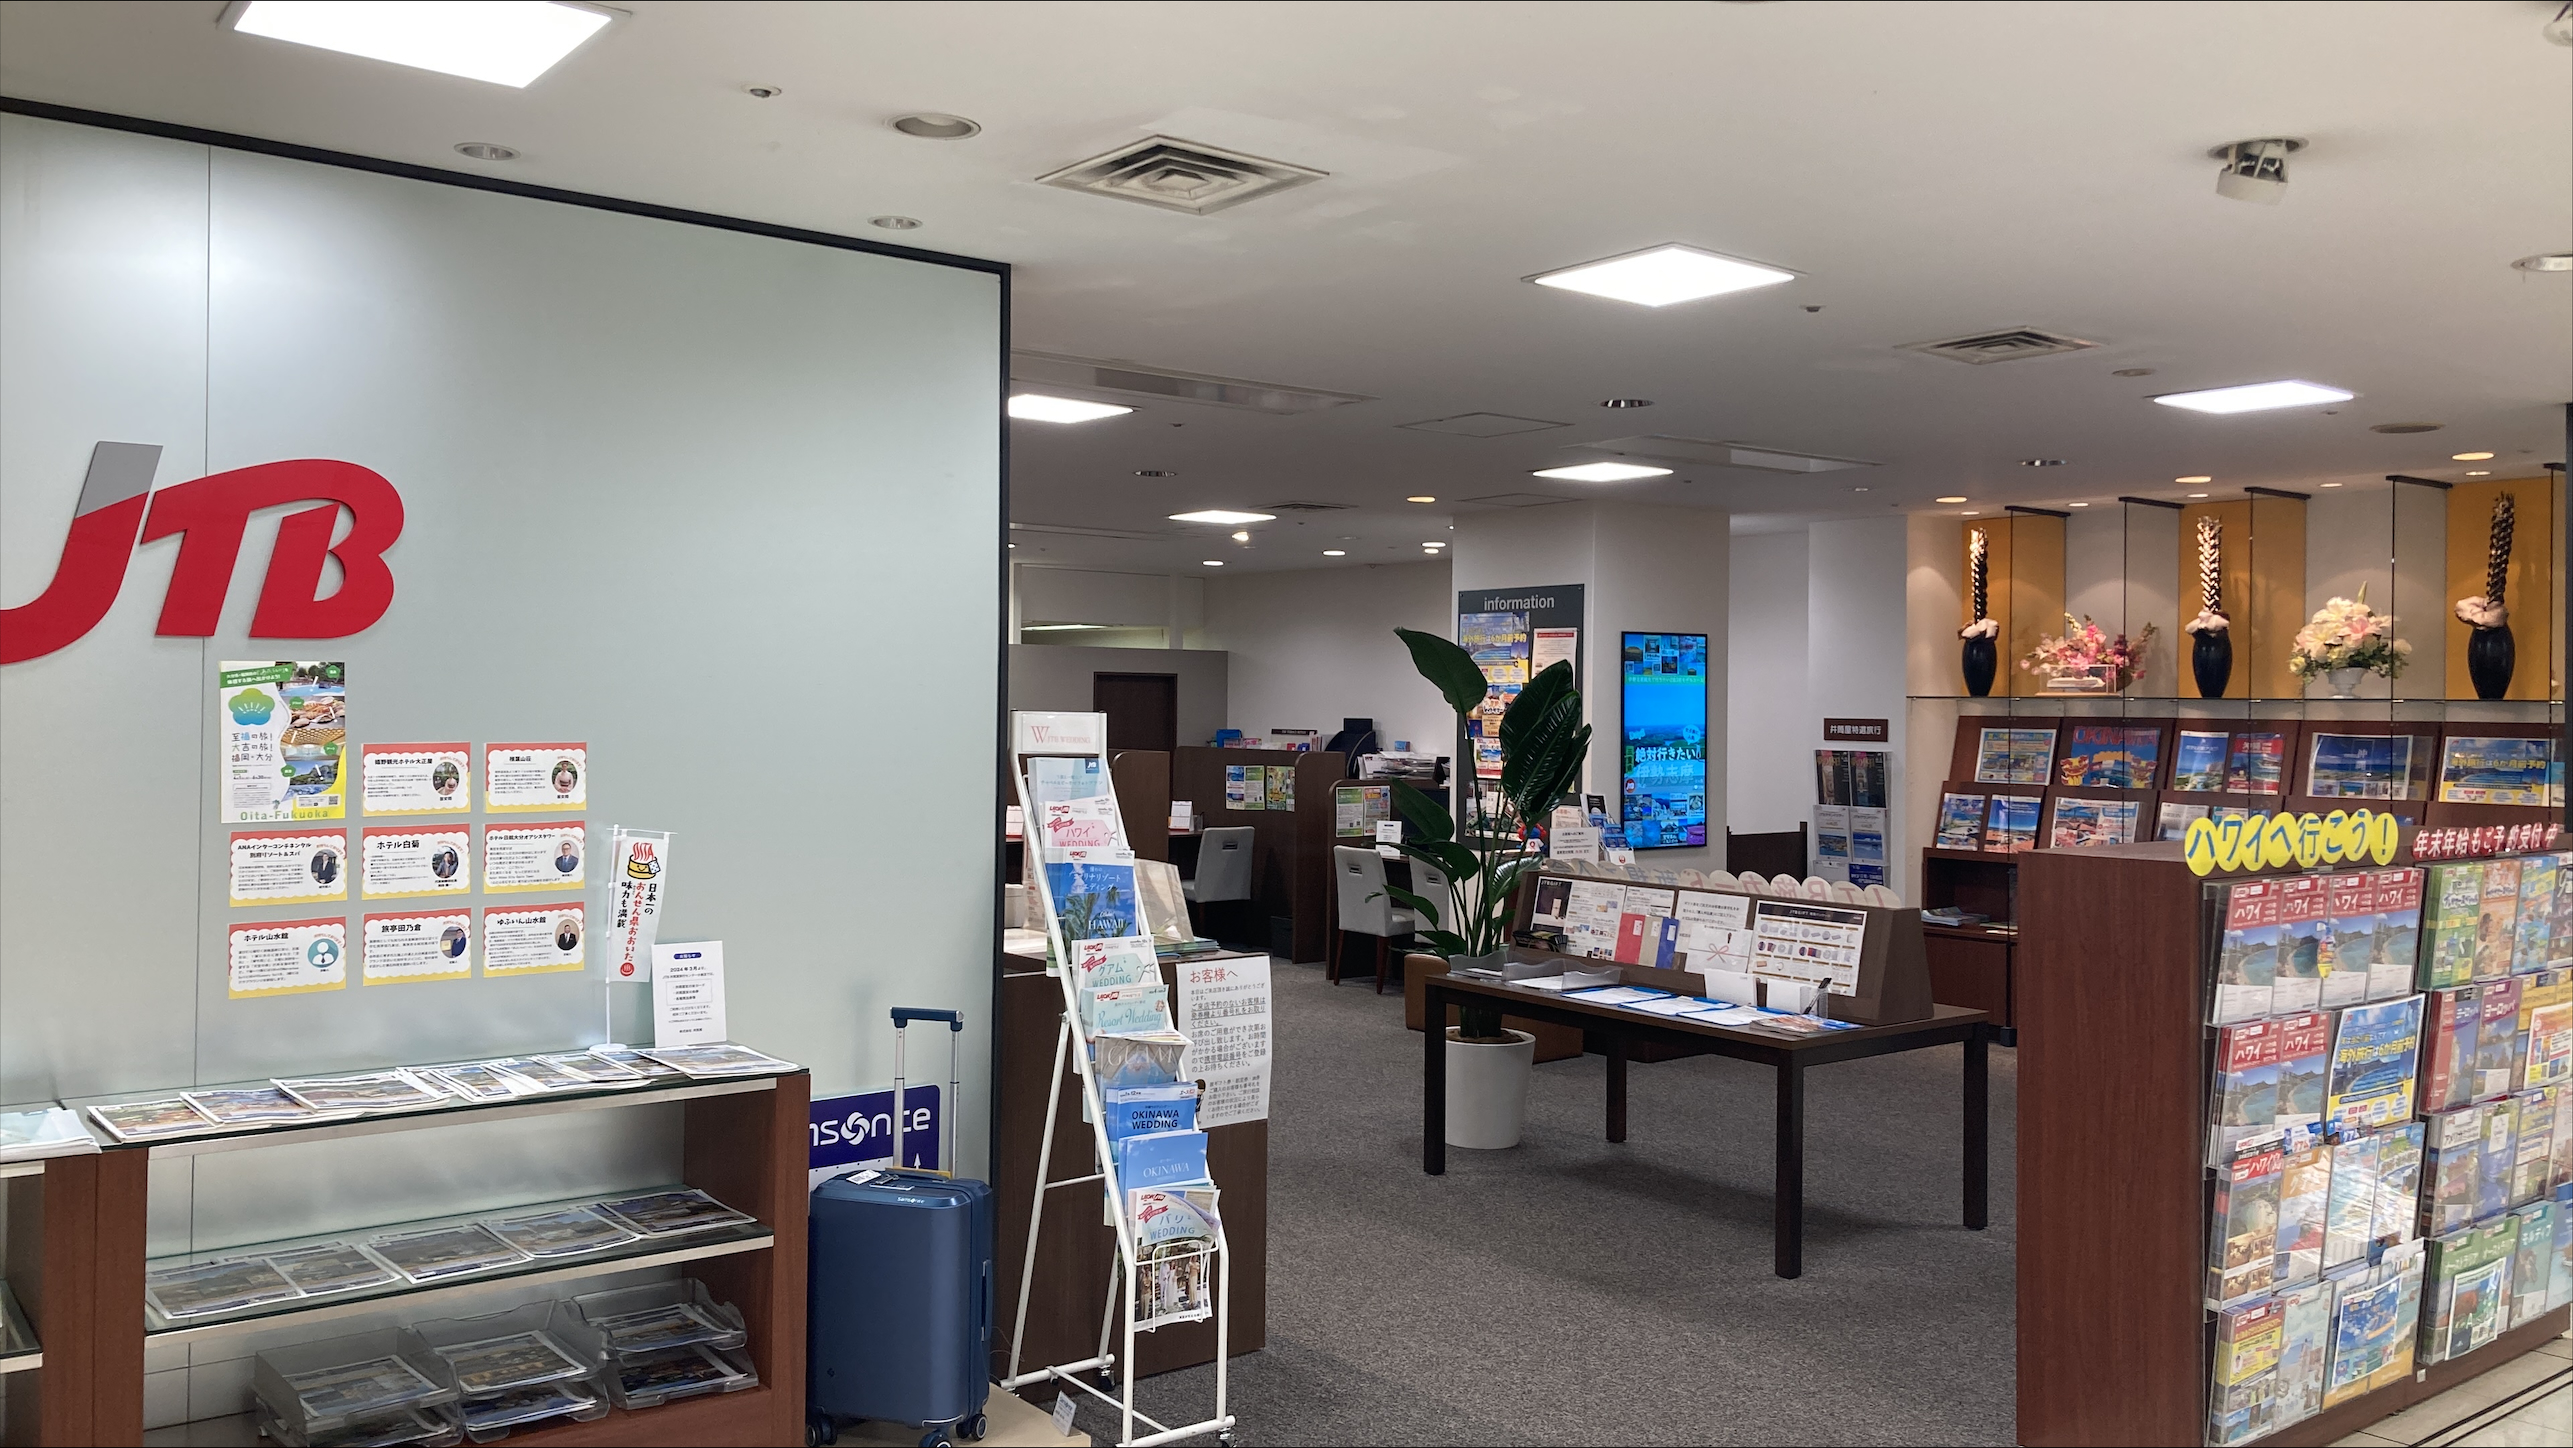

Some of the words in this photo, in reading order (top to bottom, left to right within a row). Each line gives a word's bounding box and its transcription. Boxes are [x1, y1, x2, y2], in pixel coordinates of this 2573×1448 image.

[0, 441, 404, 664] JTB
[1484, 594, 1555, 611] information
[1060, 736, 1091, 744] WEDDING
[2073, 726, 2160, 748] OKINAWA
[1637, 763, 1694, 786] 伊勢志摩
[240, 809, 329, 821] Oita-Fukuoka
[1066, 828, 1089, 838] ハワイ
[2188, 810, 2390, 861] ハワイへ行こう!
[2413, 822, 2558, 860] 年末年始もご予約受付中
[377, 840, 420, 849] ホテル白菊
[616, 880, 633, 929] 味力も満載
[644, 883, 657, 915] 日本一の
[2379, 889, 2404, 905] ハワイ
[2235, 902, 2262, 921] ハワイ
[381, 924, 422, 934] 旅亭田乃倉
[496, 916, 547, 926] ゆふいん山水館
[624, 881, 646, 962] おんせん県おおいた
[244, 932, 289, 942] ホテル山水館
[1098, 963, 1124, 976] グアム
[1190, 967, 1239, 984] お客様へ
[1092, 975, 1132, 987] WEDDING
[1191, 997, 1266, 1011] ご来店予約のないお客様は
[1097, 1011, 1124, 1028] Resort
[1125, 1008, 1162, 1027] Wedding
[1191, 1006, 1266, 1020] 発券機より番号札をお取り
[1191, 1019, 1221, 1029] ください。
[1191, 1024, 1266, 1038] お席のご用意ができ次第お
[1191, 1040, 1266, 1056] がかかる場合がございます
[2285, 1033, 2310, 1051] ハワイ
[1191, 1049, 1266, 1065] ので携帯電話番号をご登録
[2235, 1043, 2262, 1061] ハワイ
[1191, 1061, 1251, 1073] の上お待ちください。
[1132, 1109, 1180, 1120] OKINAWA
[1132, 1120, 1178, 1130] WEDDING
[1143, 1162, 1190, 1178] OKINAWA
[1150, 1226, 1195, 1240] WEDDING
